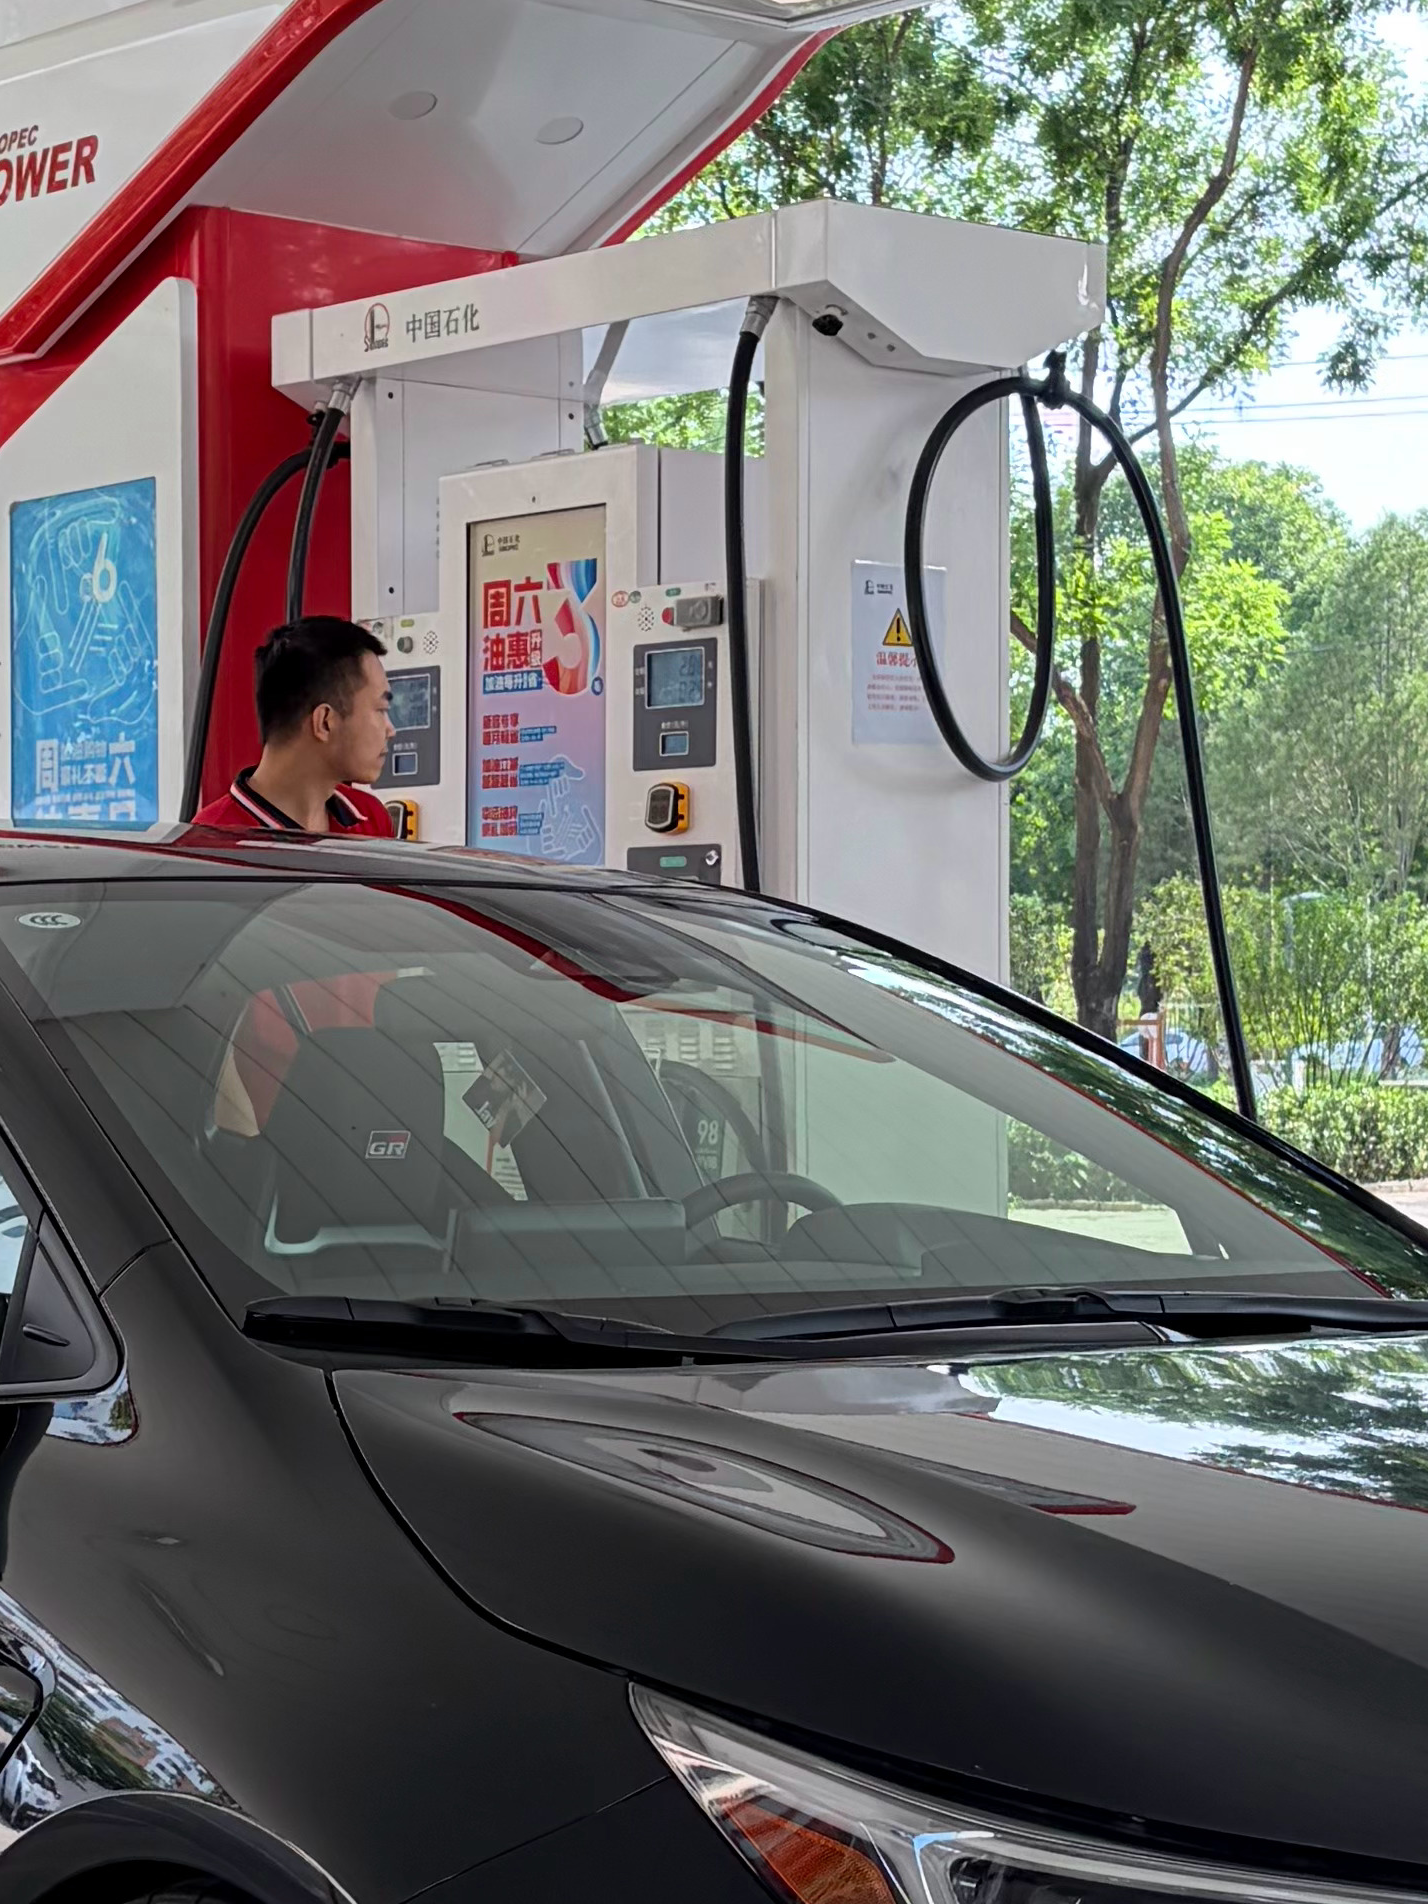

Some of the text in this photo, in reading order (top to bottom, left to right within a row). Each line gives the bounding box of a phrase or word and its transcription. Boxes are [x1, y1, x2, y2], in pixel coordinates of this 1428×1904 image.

[406, 303, 480, 343] 中国石化
[483, 576, 543, 629] 周六
[483, 631, 529, 672] 油惠
[36, 731, 136, 795] 周 六
[475, 1100, 498, 1129] Jay
[697, 1119, 720, 1145] 98
[369, 1142, 406, 1156] GR
